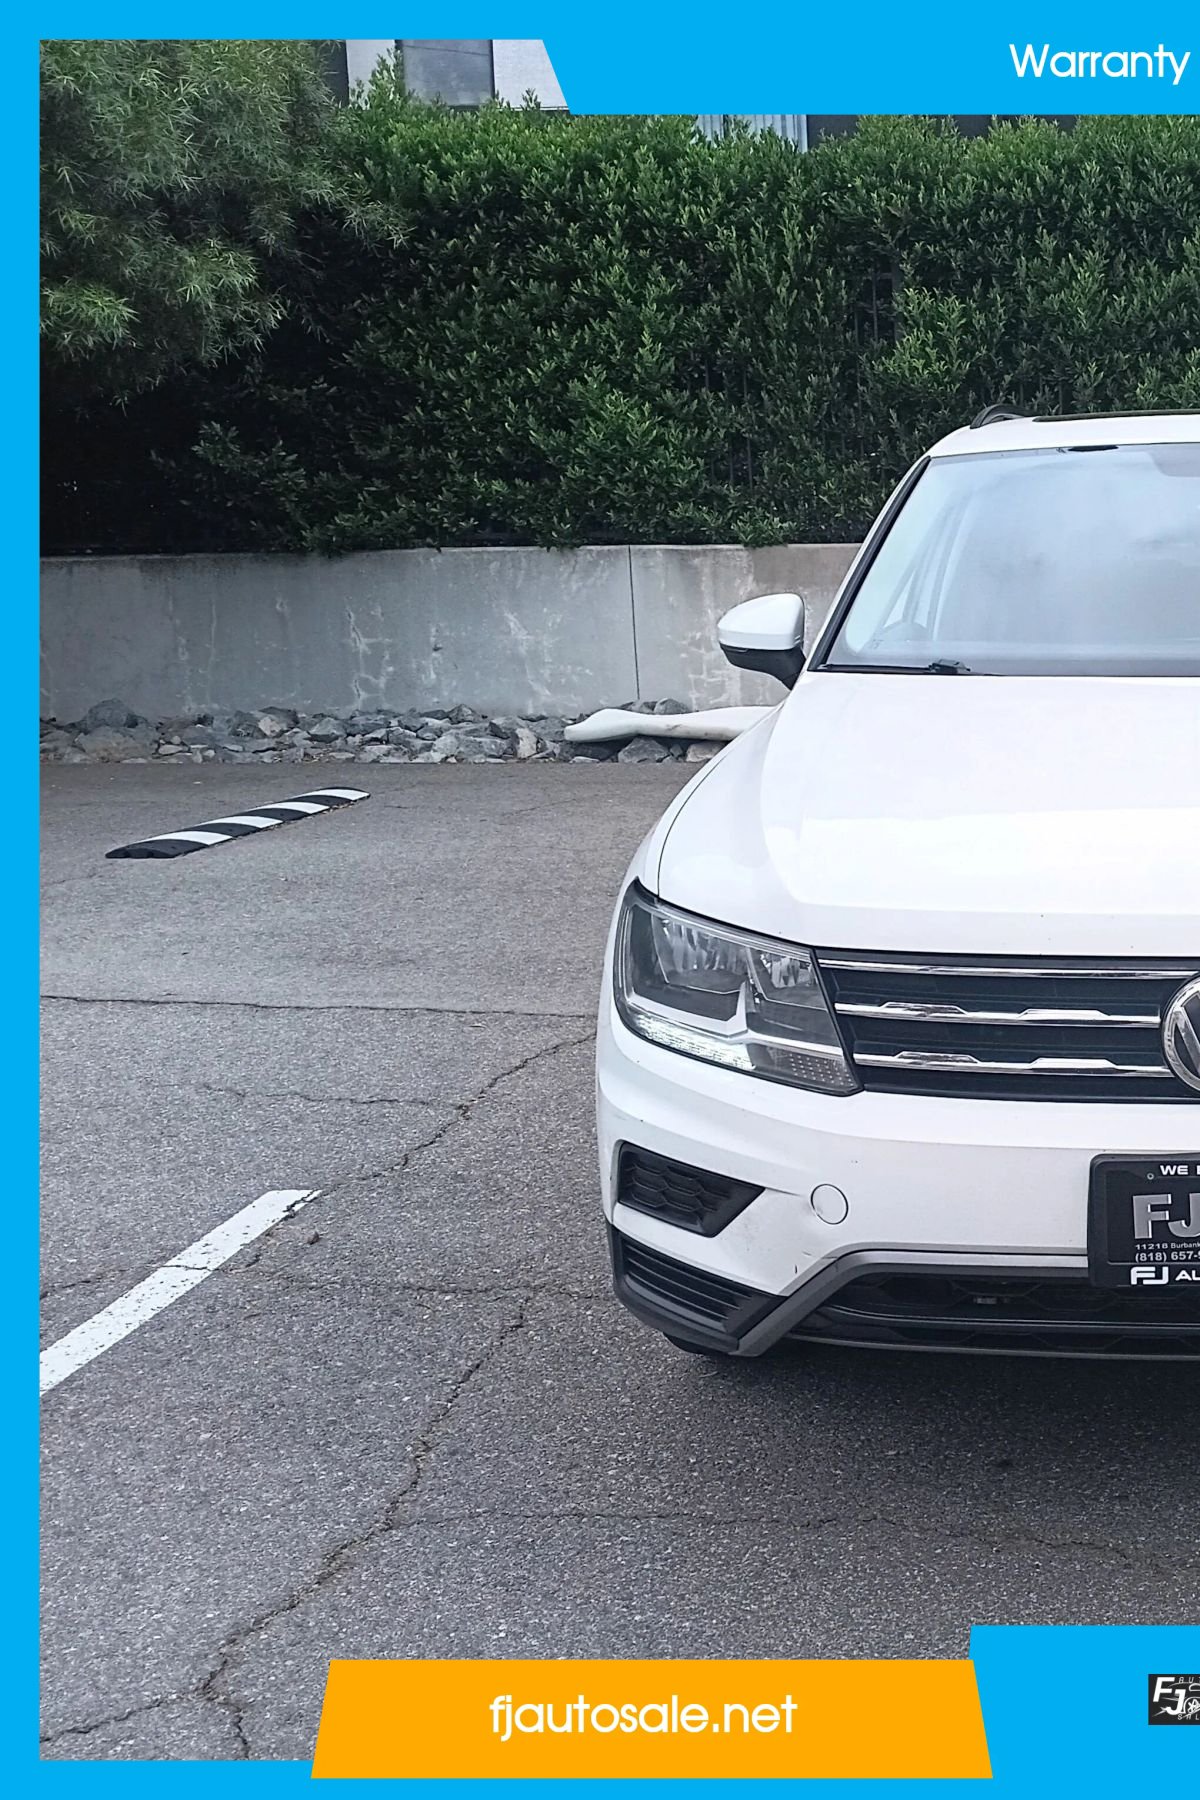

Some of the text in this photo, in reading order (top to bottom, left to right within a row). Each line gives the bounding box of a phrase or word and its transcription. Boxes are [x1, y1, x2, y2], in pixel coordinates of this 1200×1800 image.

[1160, 1165, 1188, 1175] WE
[1170, 1241, 1200, 1249] Burbank
[1135, 1252, 1167, 1263] (818)
[1130, 1266, 1169, 1285] FJ
